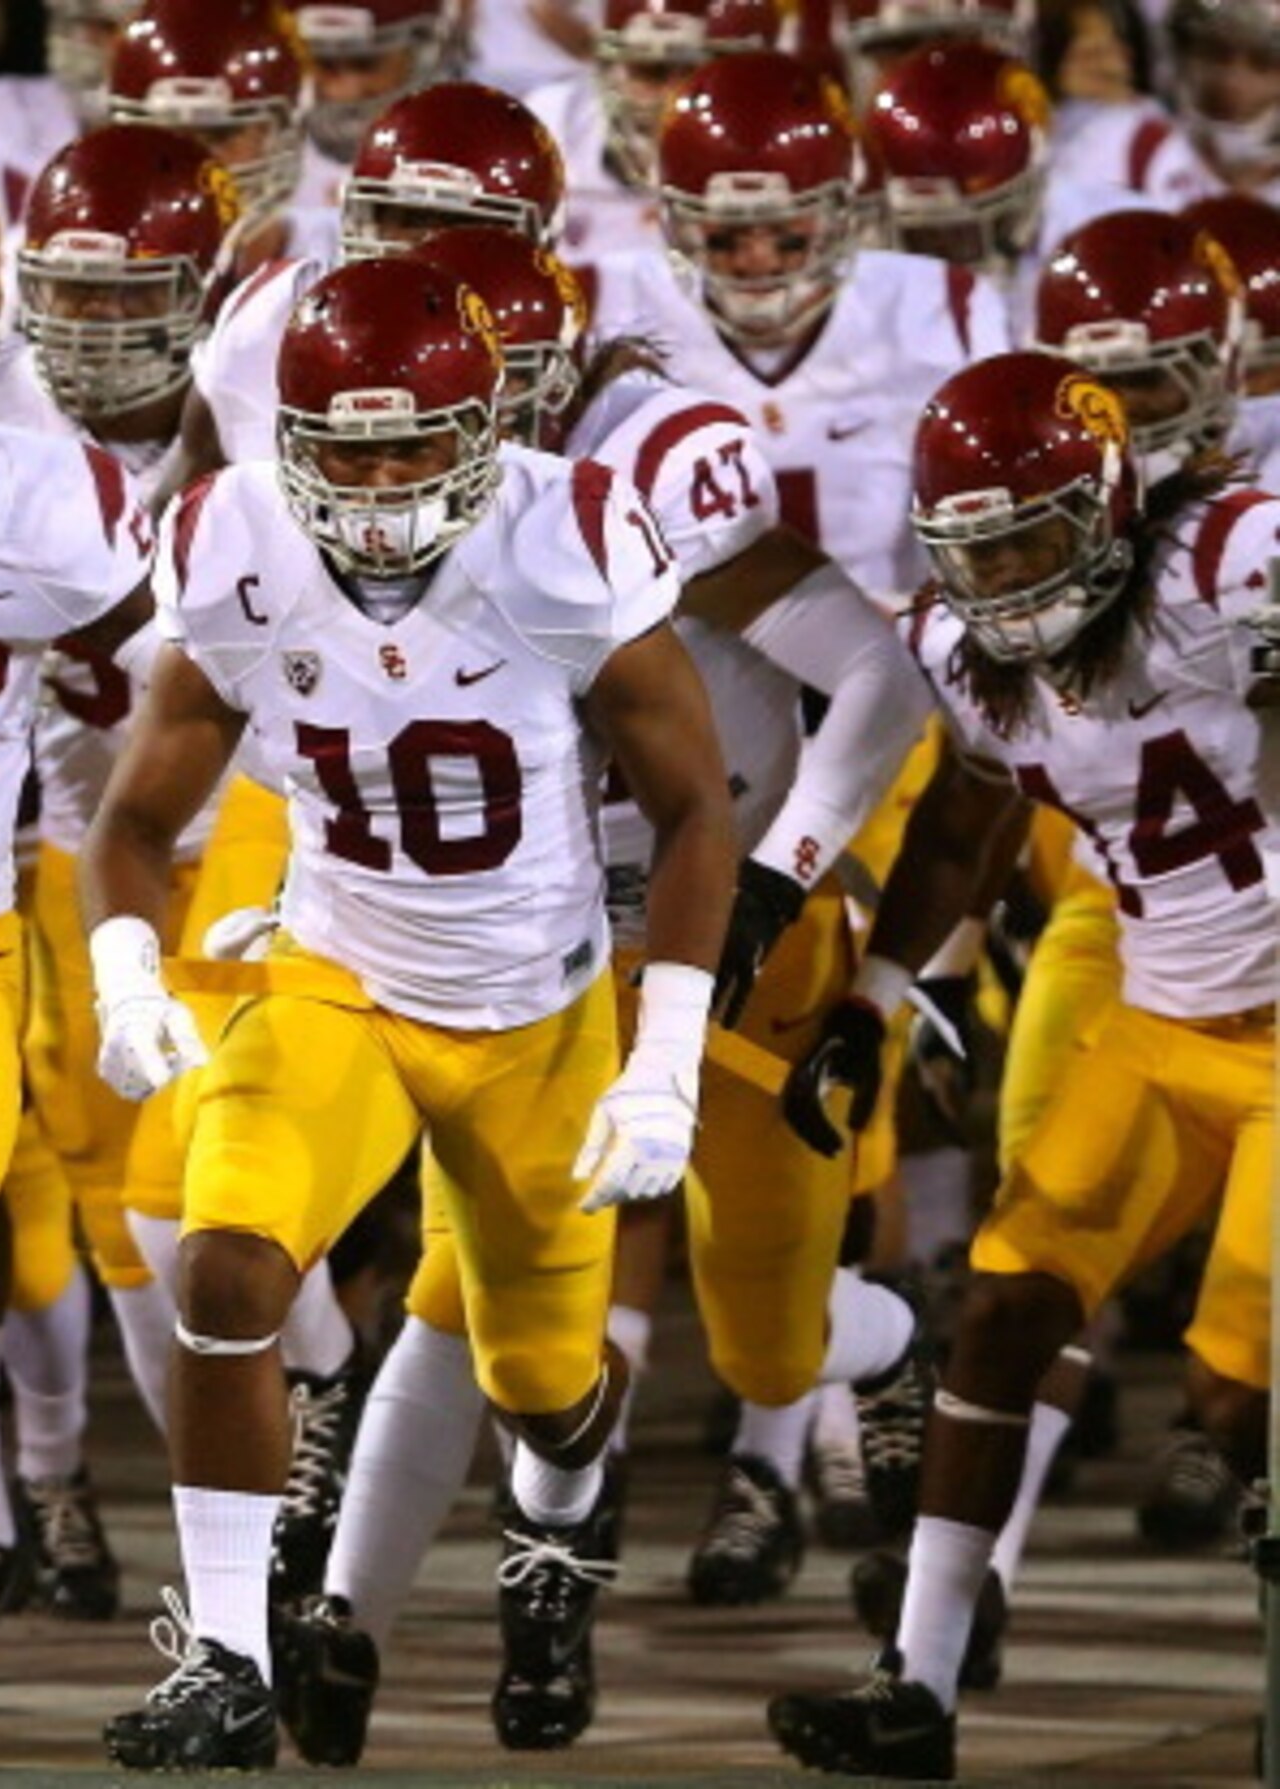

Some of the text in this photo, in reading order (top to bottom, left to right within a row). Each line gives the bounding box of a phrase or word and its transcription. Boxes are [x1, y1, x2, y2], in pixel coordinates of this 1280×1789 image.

[689, 438, 760, 523] 47
[626, 509, 677, 578] 1
[236, 574, 269, 625] C
[378, 644, 407, 679] SC
[293, 717, 523, 877] 10
